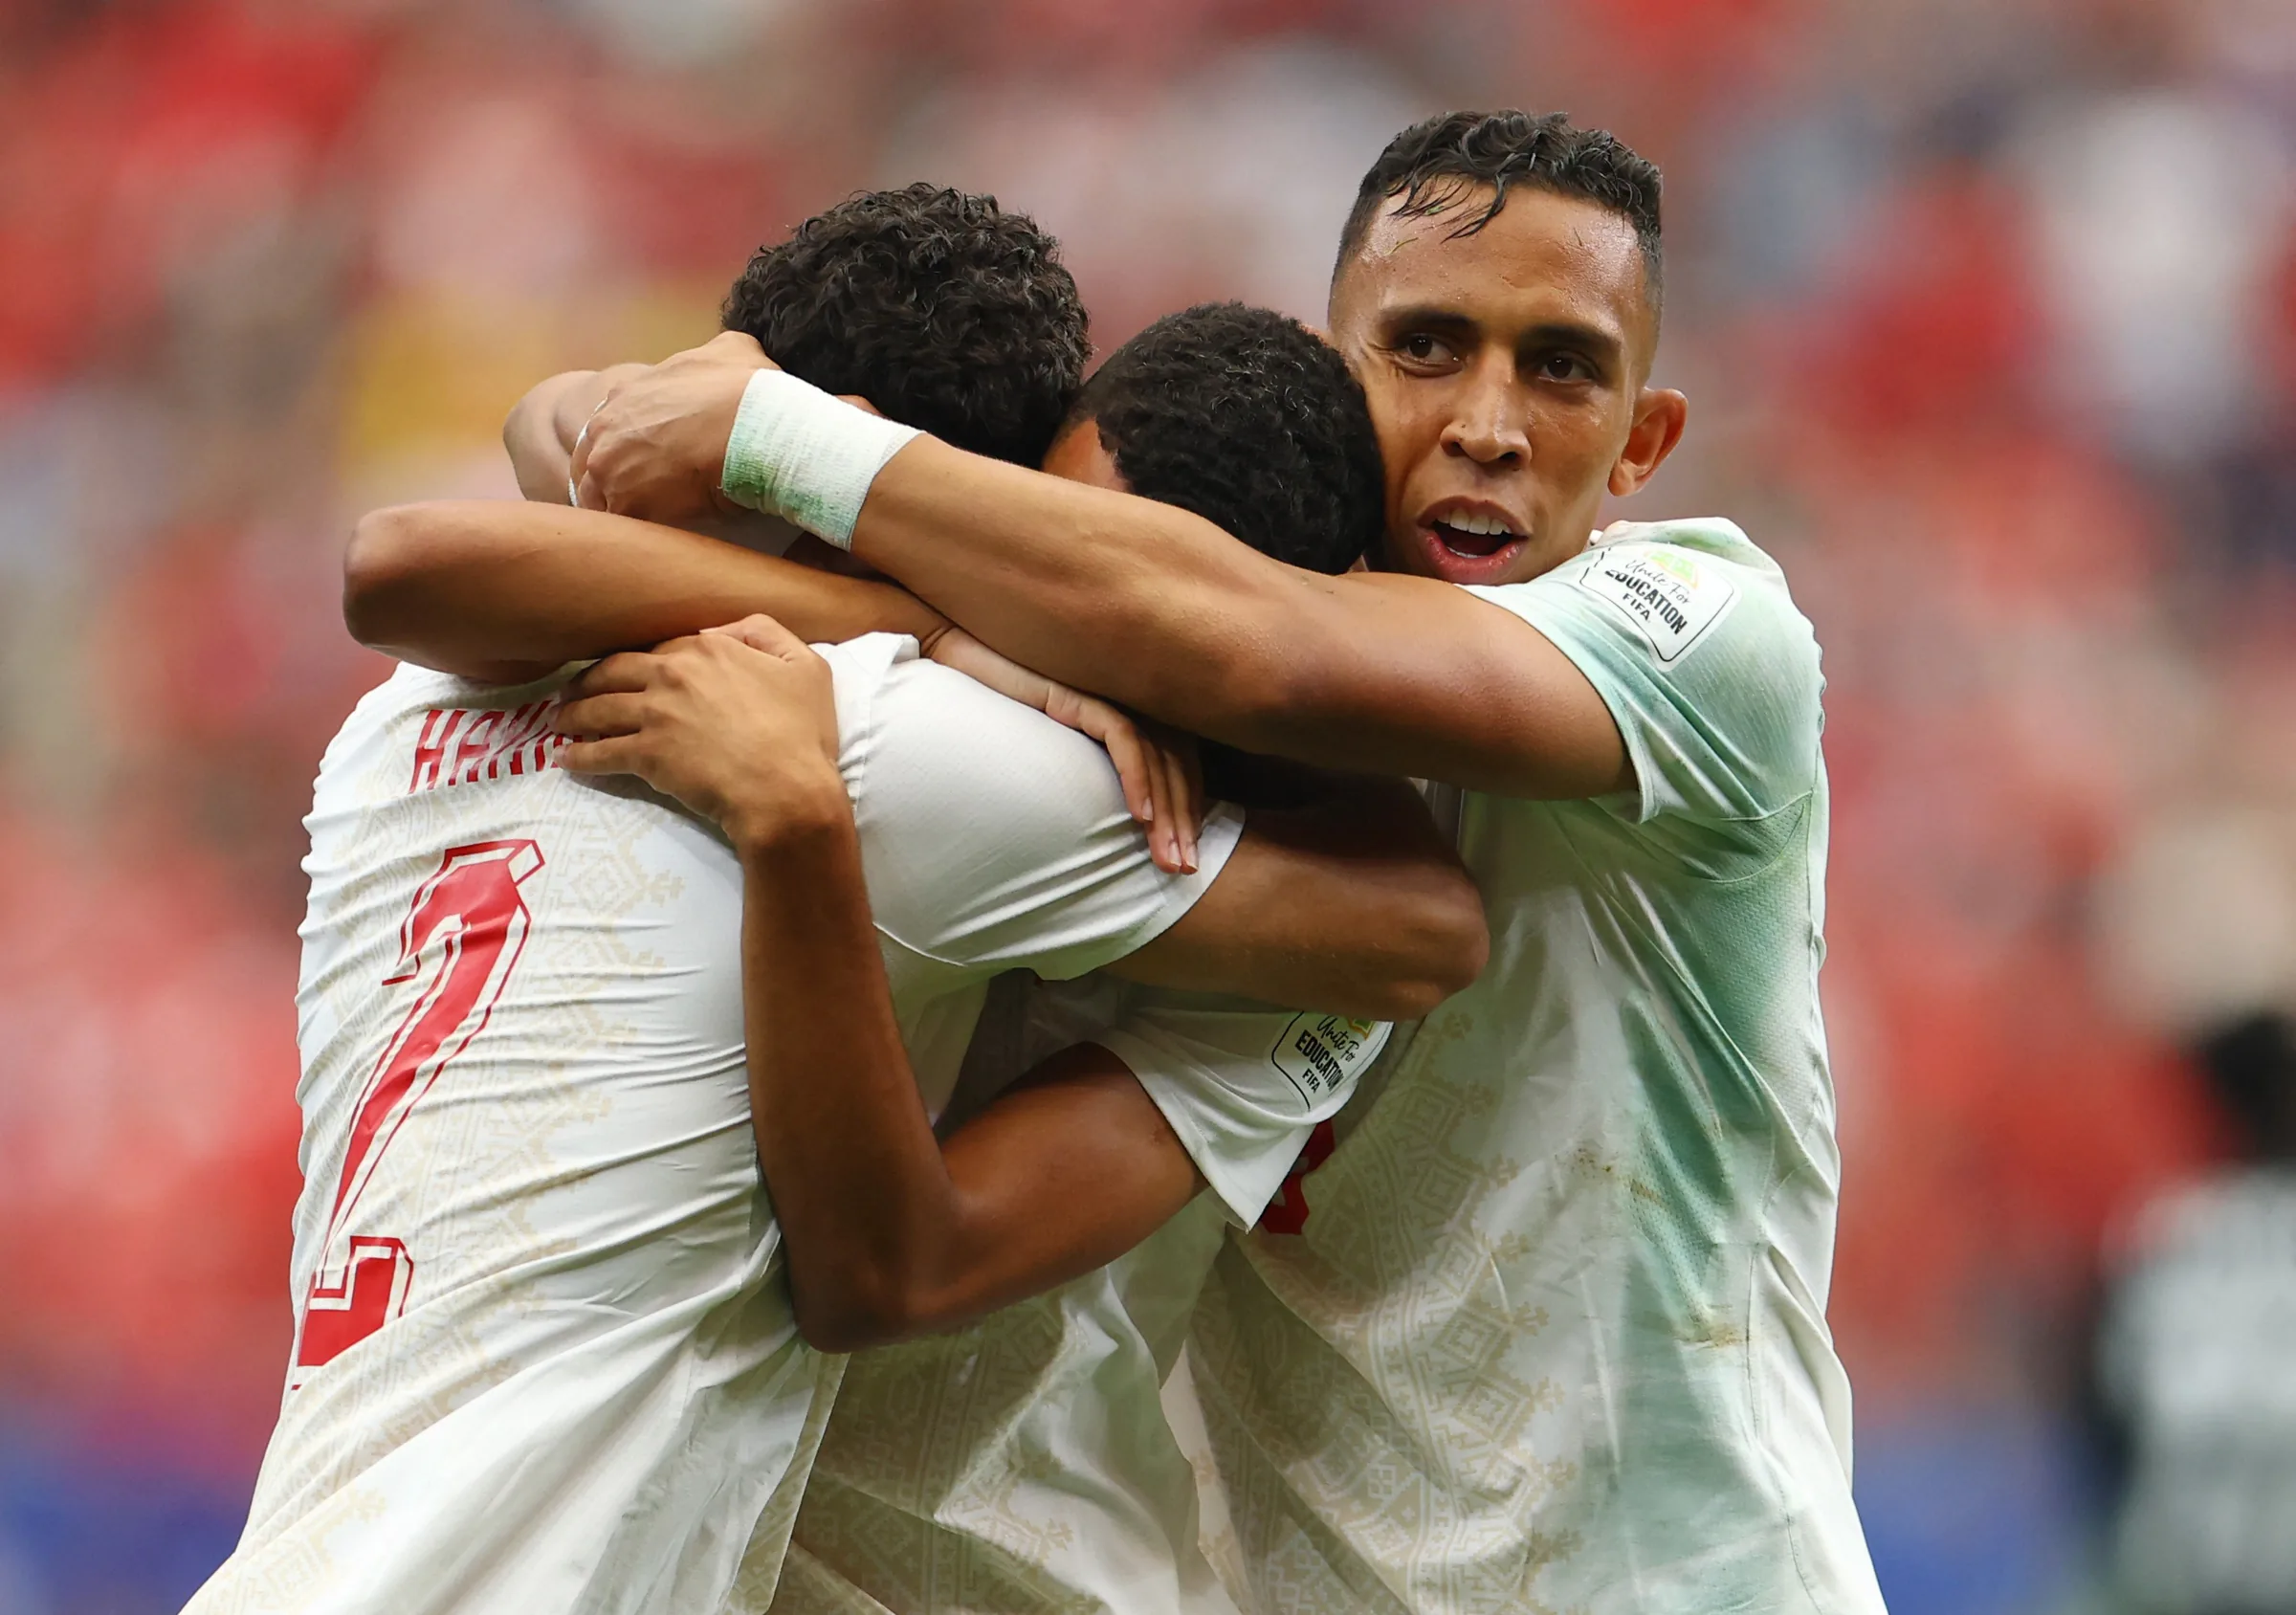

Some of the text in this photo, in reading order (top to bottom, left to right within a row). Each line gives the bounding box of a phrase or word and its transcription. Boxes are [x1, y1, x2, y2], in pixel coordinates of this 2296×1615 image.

[1623, 592, 1651, 622] FIFA
[1316, 1015, 1359, 1063] Unite For
[1301, 1068, 1320, 1094] FIFA
